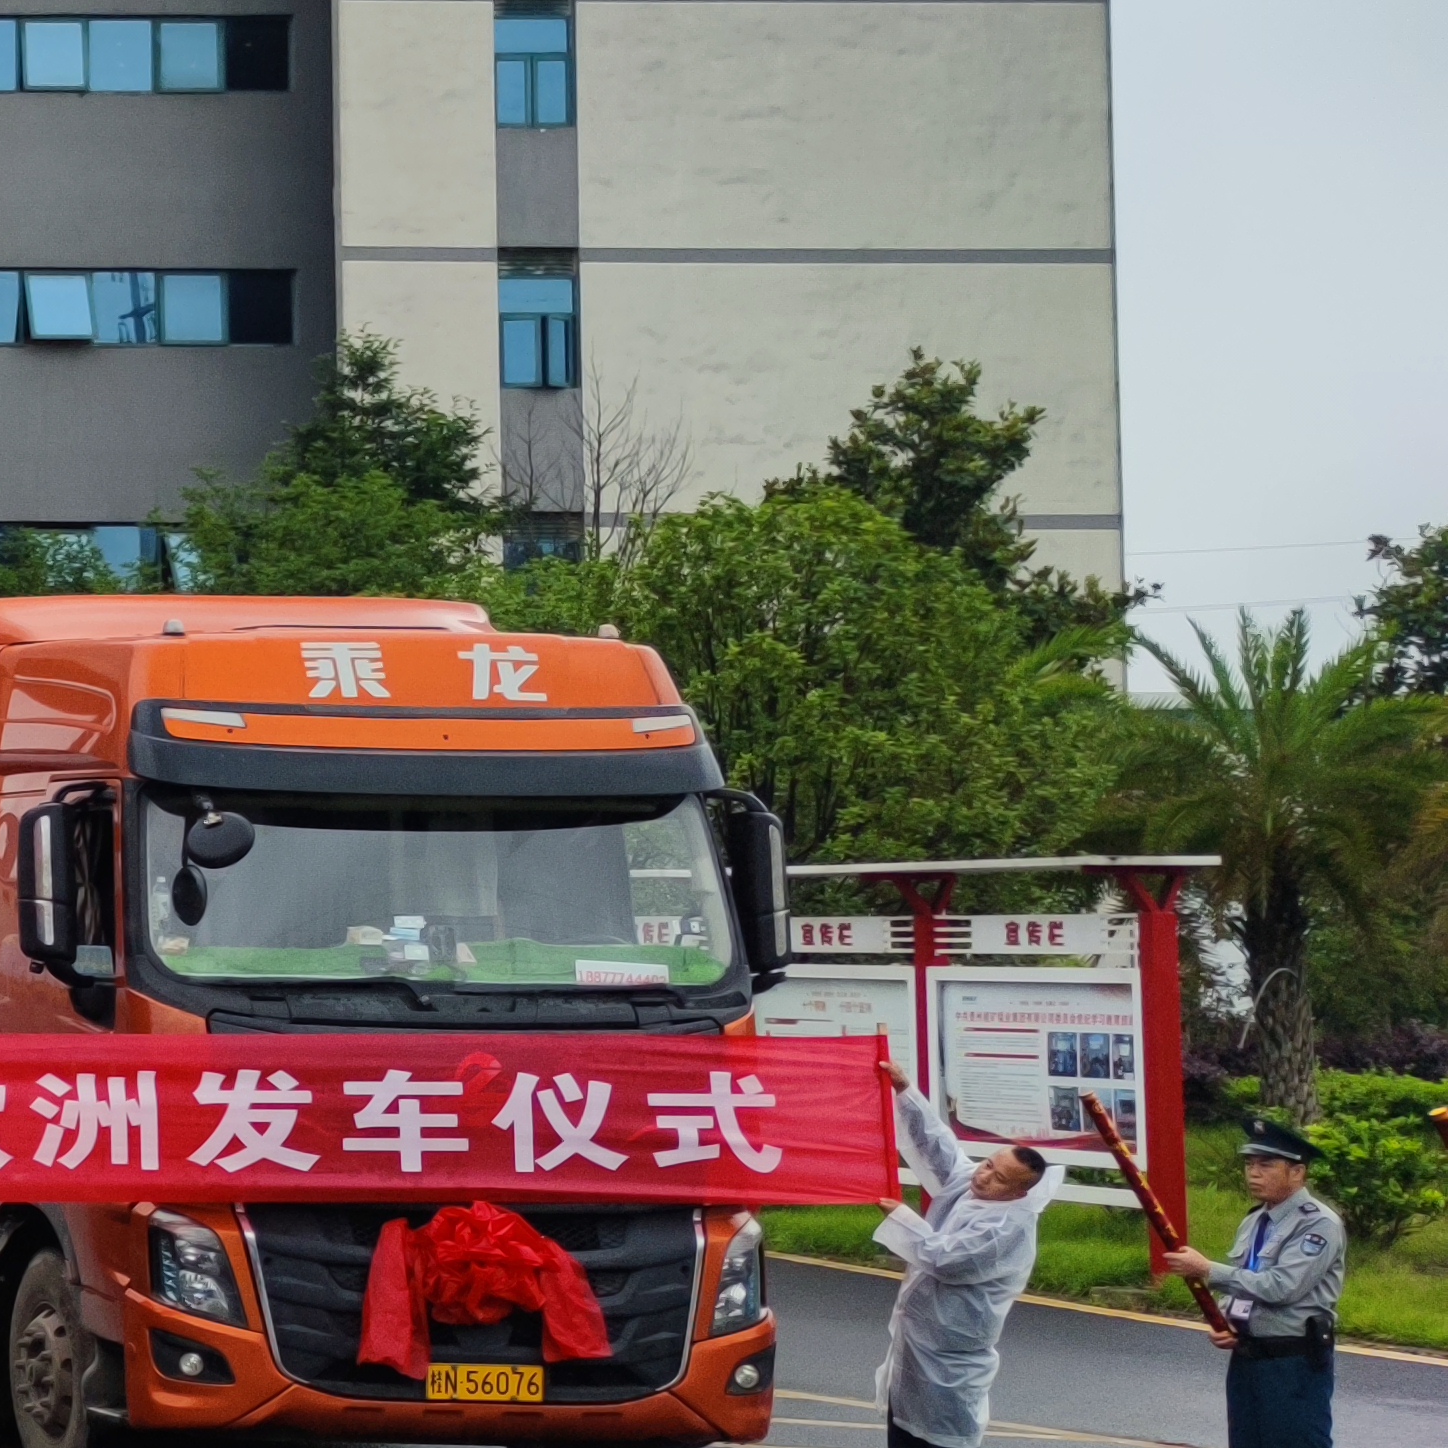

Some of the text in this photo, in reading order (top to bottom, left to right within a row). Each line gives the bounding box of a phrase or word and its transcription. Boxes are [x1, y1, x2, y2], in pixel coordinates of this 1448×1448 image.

[299, 641, 547, 702] 乘龙
[801, 922, 853, 946] 宣传栏
[1004, 921, 1064, 946] 宣传栏
